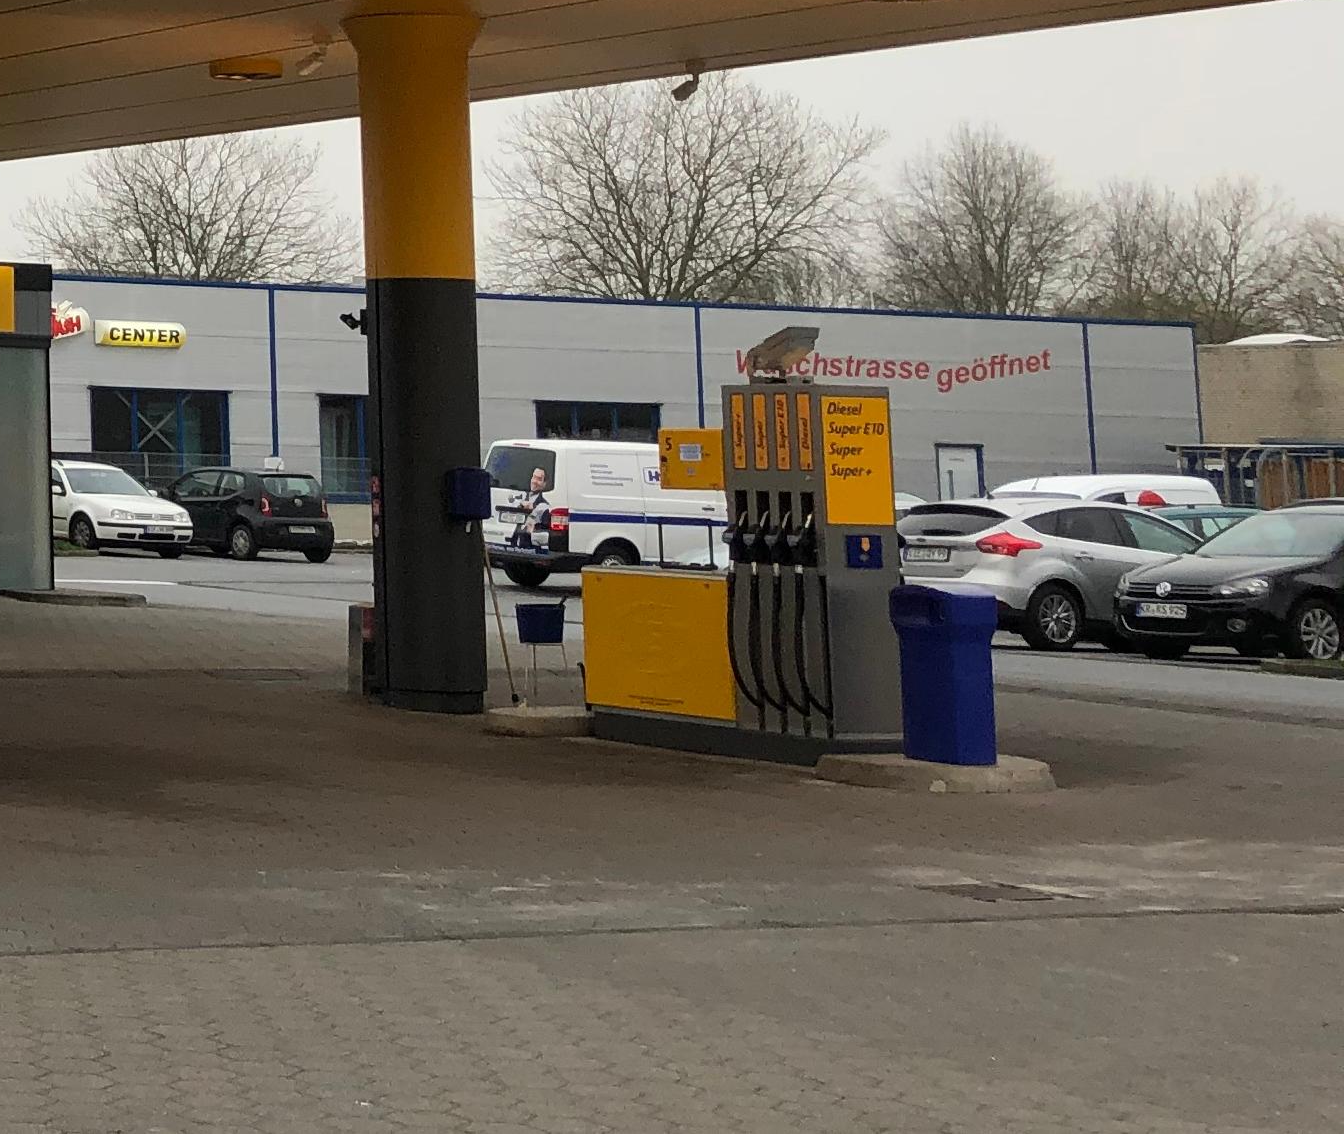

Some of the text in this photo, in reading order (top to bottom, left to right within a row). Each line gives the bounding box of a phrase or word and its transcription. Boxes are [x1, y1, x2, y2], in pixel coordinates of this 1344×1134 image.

[109, 327, 180, 344] CENTER
[936, 348, 1052, 393] geöffnet
[827, 401, 862, 415] Diesel
[827, 421, 885, 438] Super E10
[665, 438, 672, 451] 5
[829, 442, 864, 460] Super
